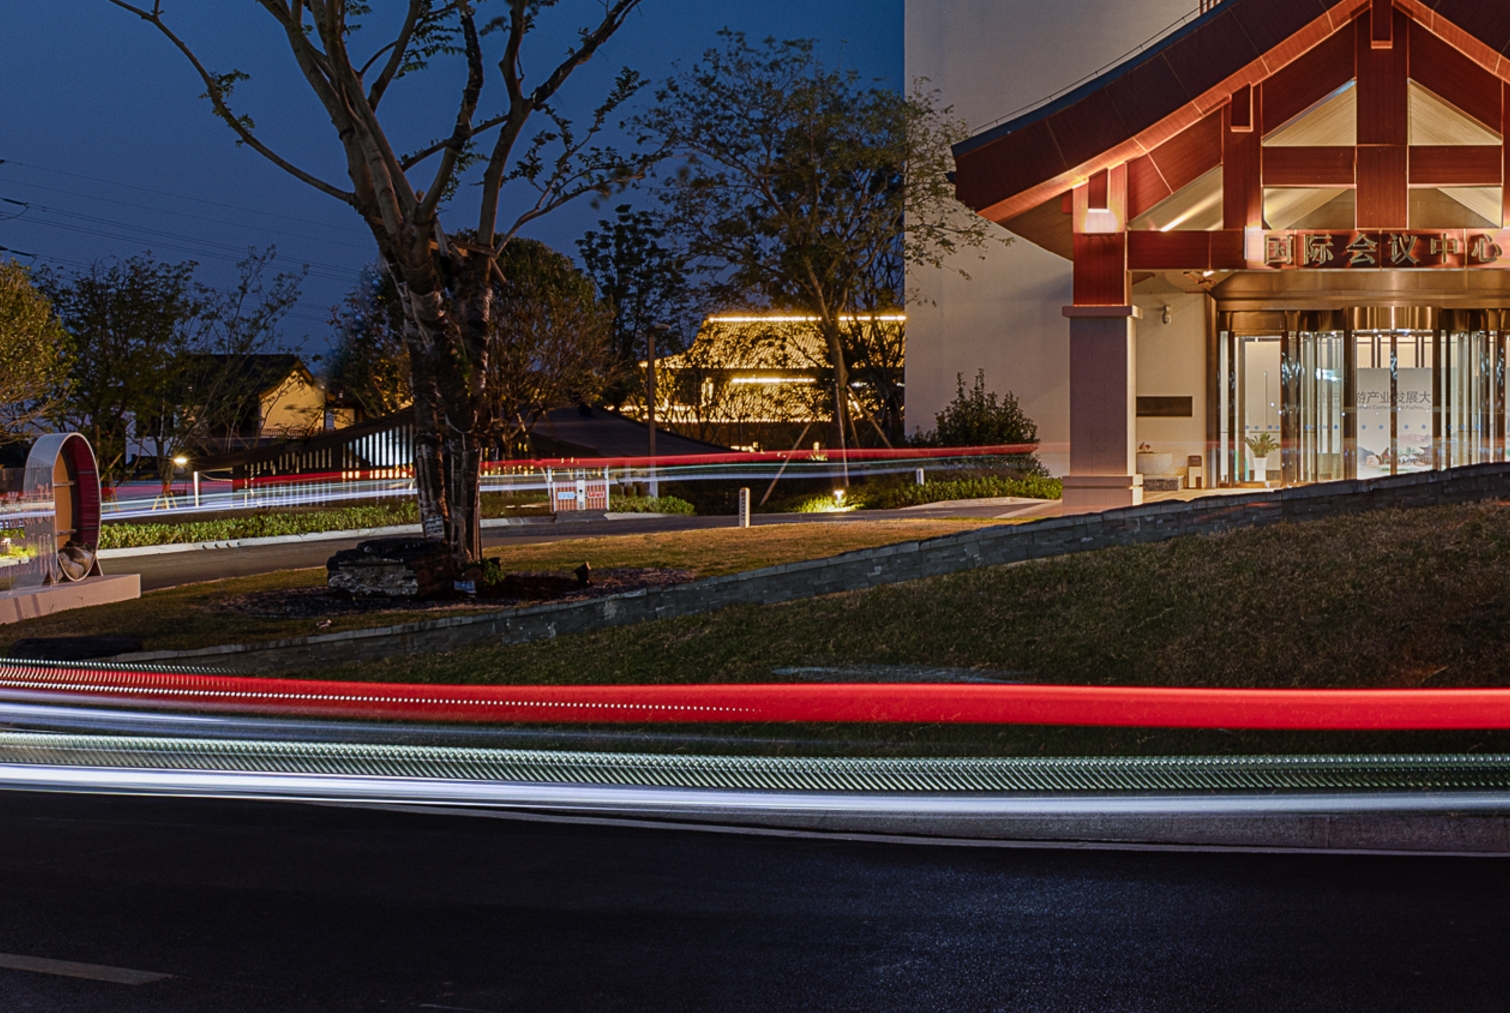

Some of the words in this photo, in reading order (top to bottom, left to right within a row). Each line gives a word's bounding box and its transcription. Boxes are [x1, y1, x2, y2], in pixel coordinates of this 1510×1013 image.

[1263, 232, 1503, 265] 国际会议中心
